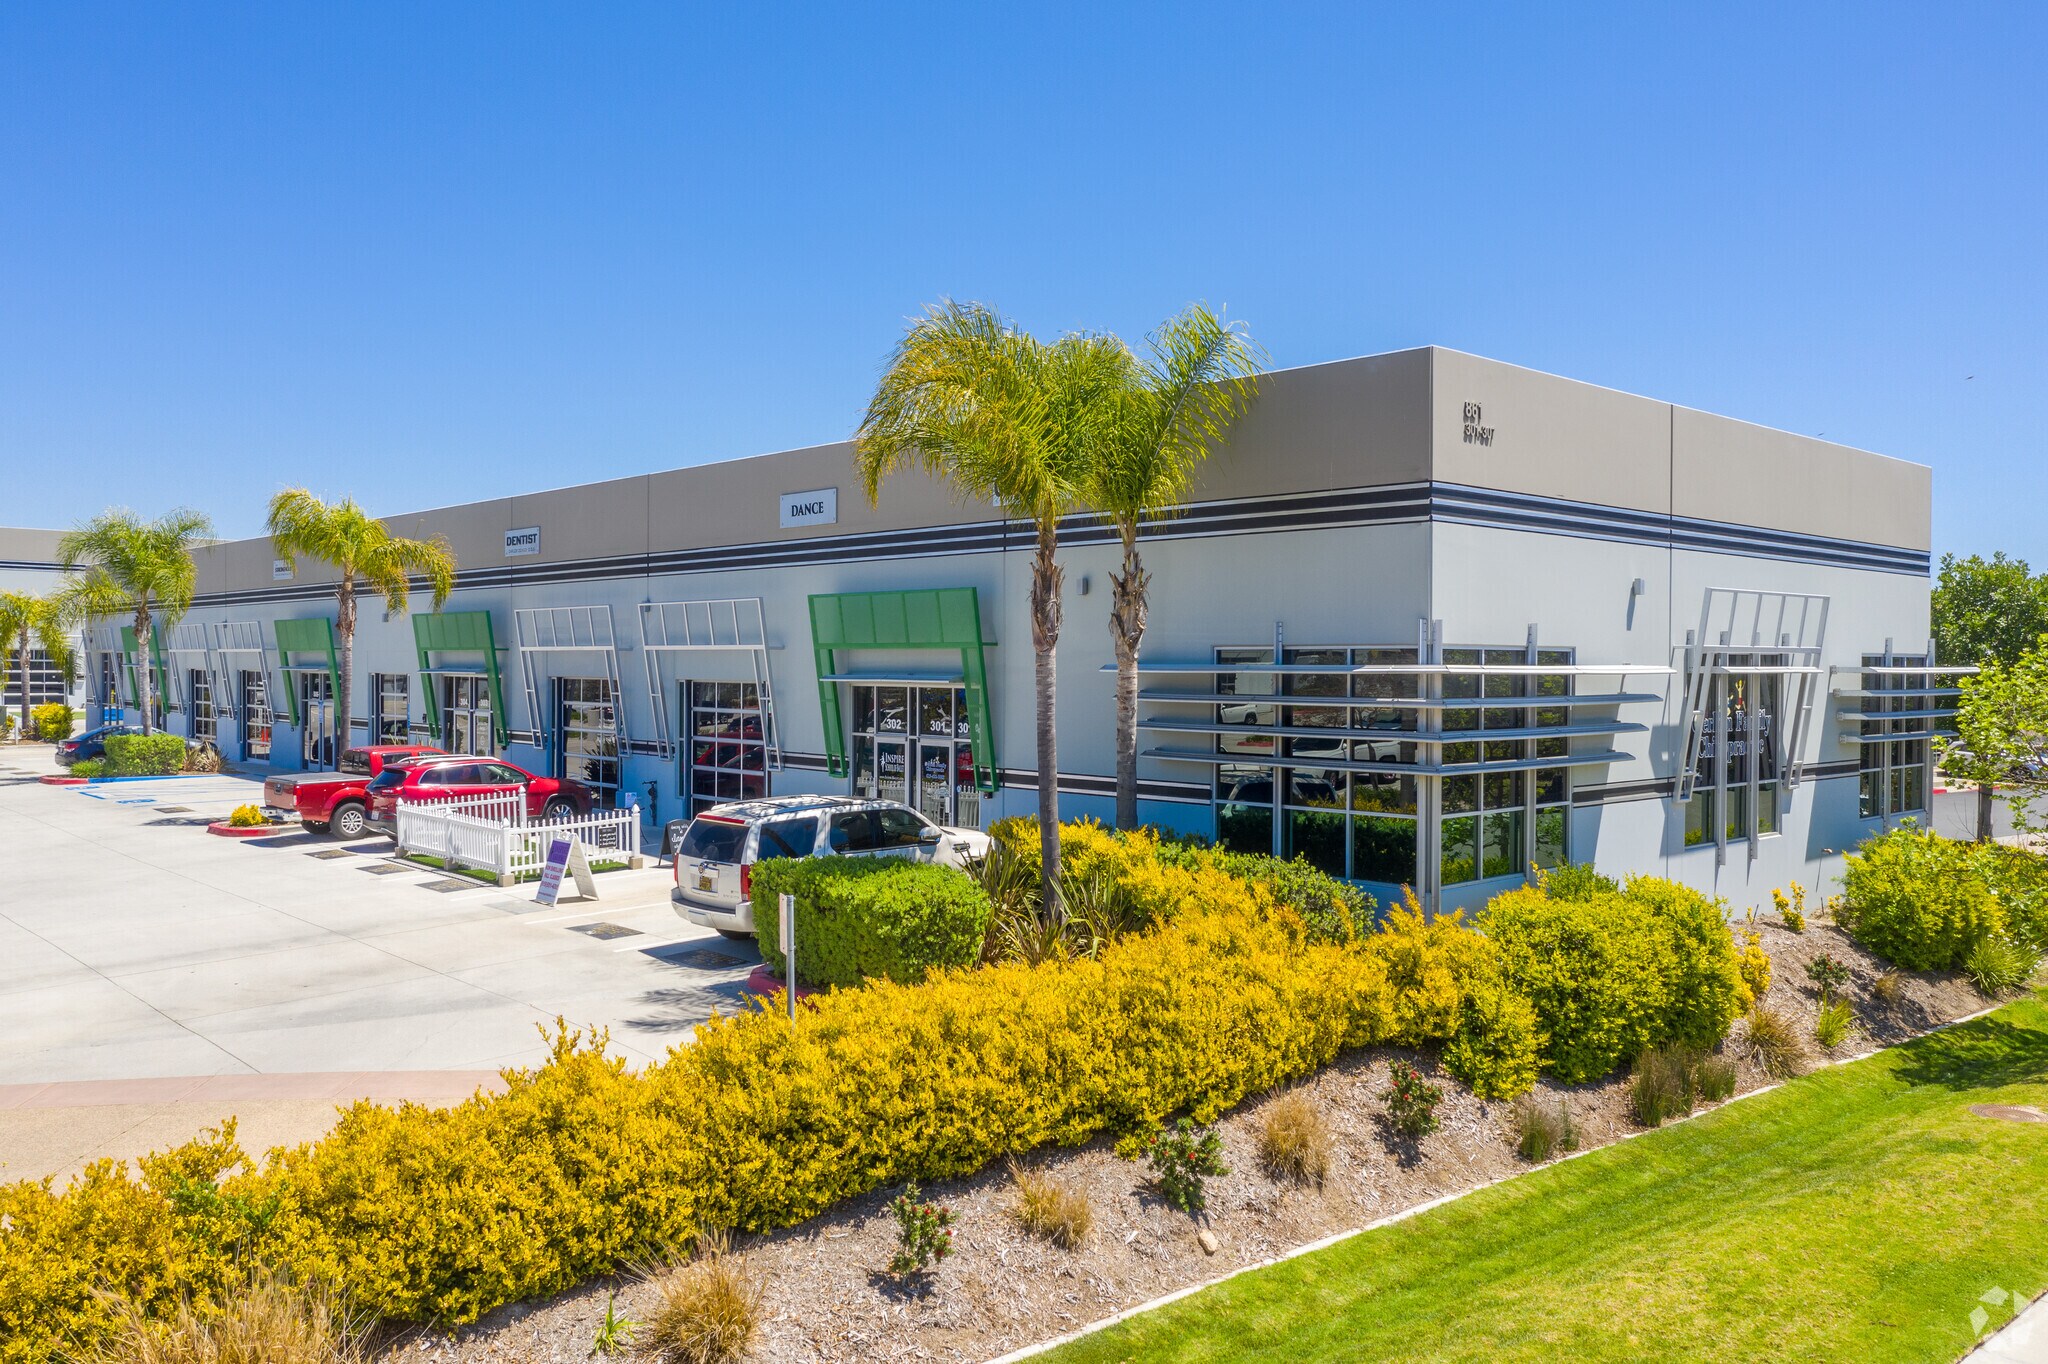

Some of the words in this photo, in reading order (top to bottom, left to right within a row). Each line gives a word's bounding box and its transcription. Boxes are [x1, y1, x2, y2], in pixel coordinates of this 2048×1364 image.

[791, 501, 824, 517] DANCE
[506, 533, 538, 546] DENTIST
[886, 719, 902, 729] 302
[930, 721, 945, 731] 301
[957, 722, 970, 733] 30
